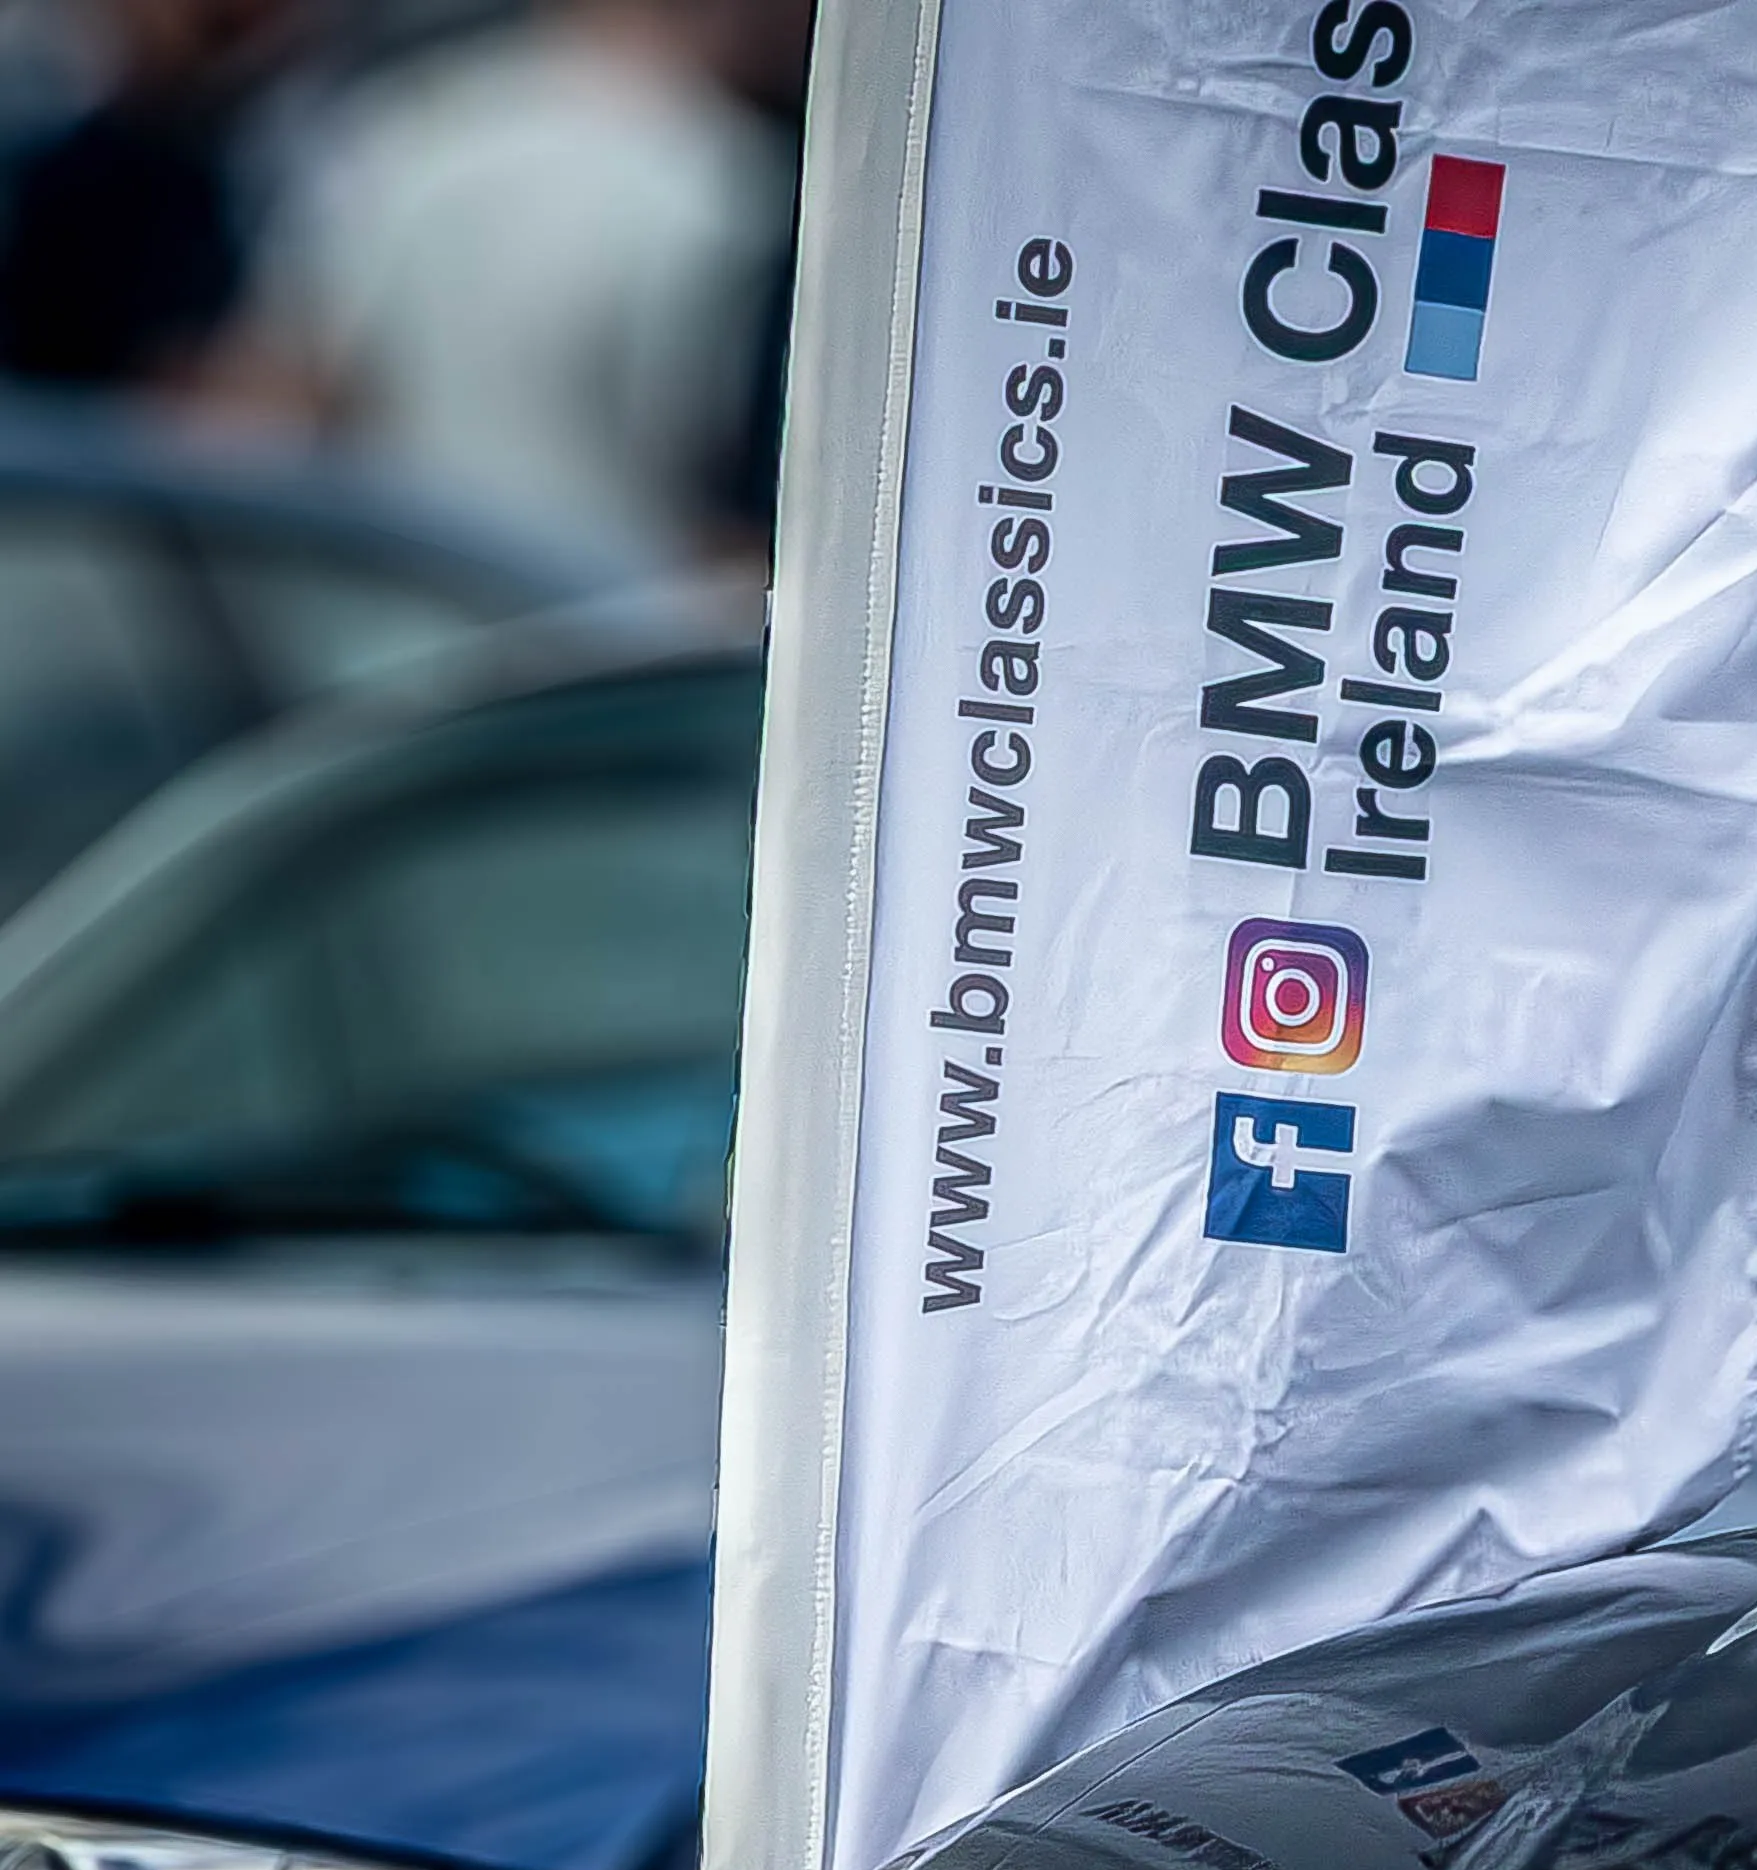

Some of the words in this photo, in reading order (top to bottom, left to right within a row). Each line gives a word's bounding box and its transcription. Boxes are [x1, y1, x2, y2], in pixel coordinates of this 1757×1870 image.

[922, 238, 1073, 1314] www.bmwclassics.ie
[1190, 405, 1354, 870] BMW
[1324, 431, 1476, 880] Ireland
